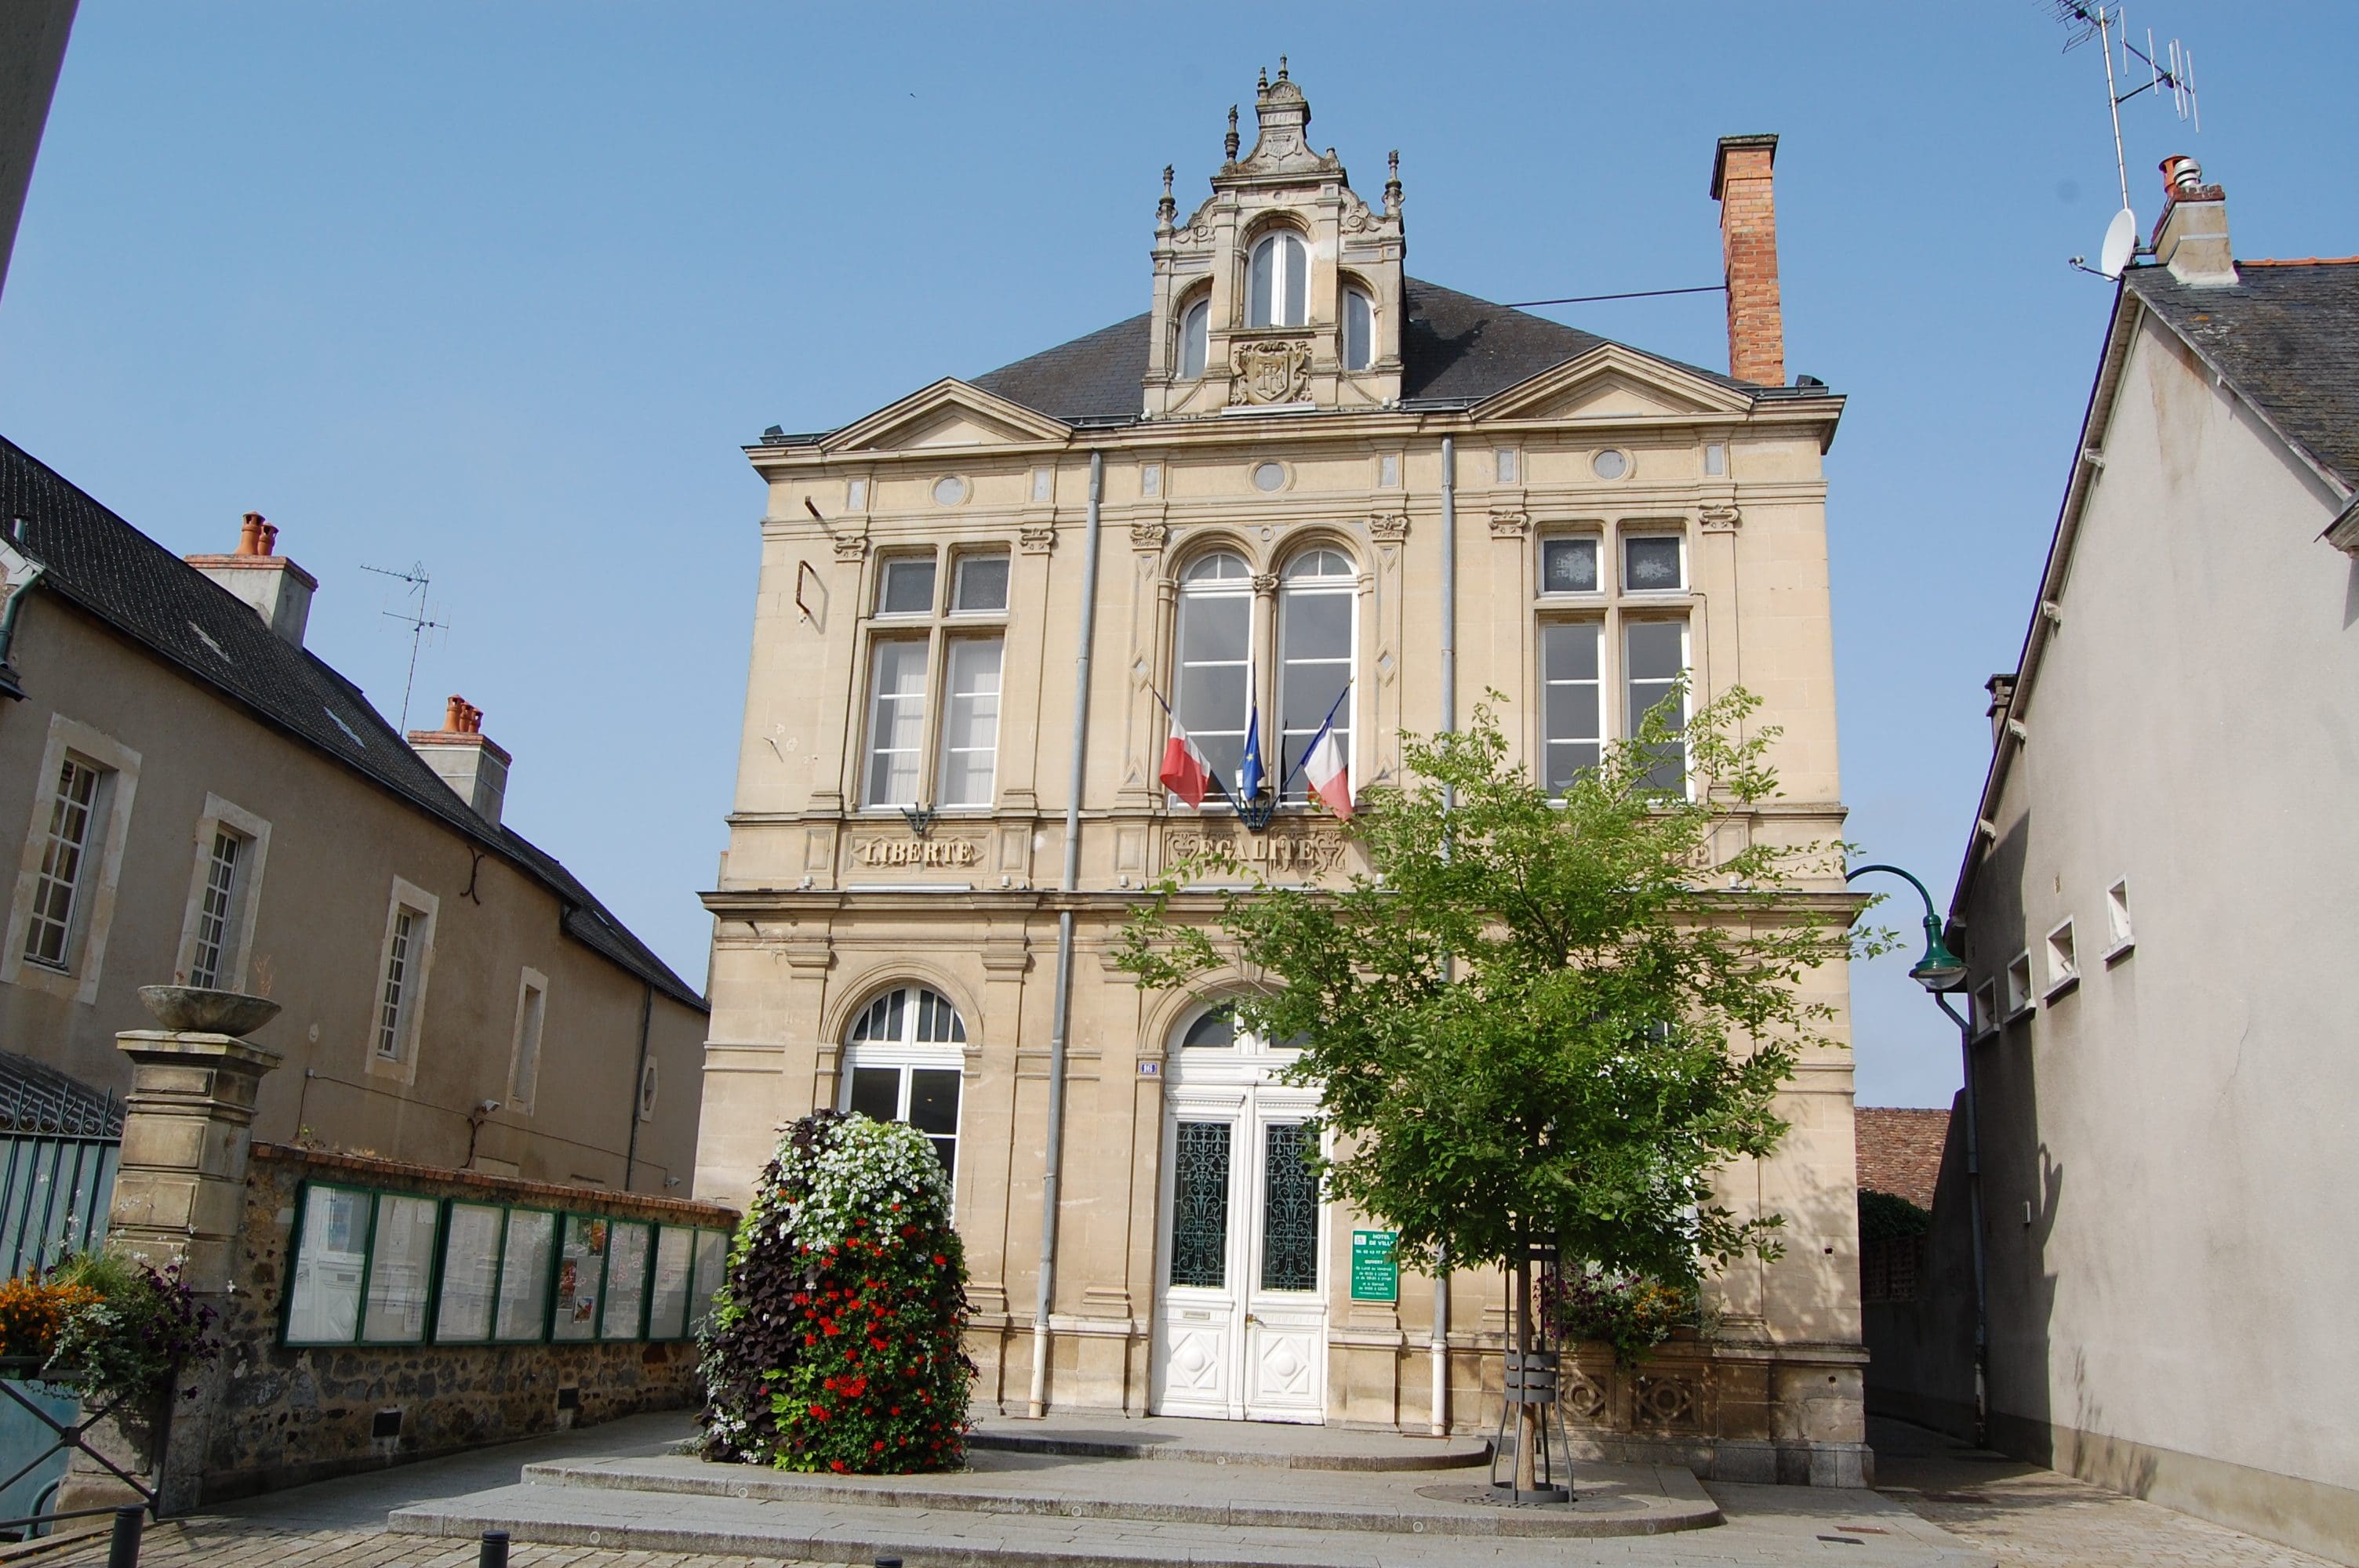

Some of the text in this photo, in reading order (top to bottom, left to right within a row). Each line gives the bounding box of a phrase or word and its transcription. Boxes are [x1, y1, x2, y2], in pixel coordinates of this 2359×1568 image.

[864, 841, 972, 863] LIBERTE
[1197, 839, 1316, 861] EGALITE
[1143, 1064, 1153, 1073] 16
